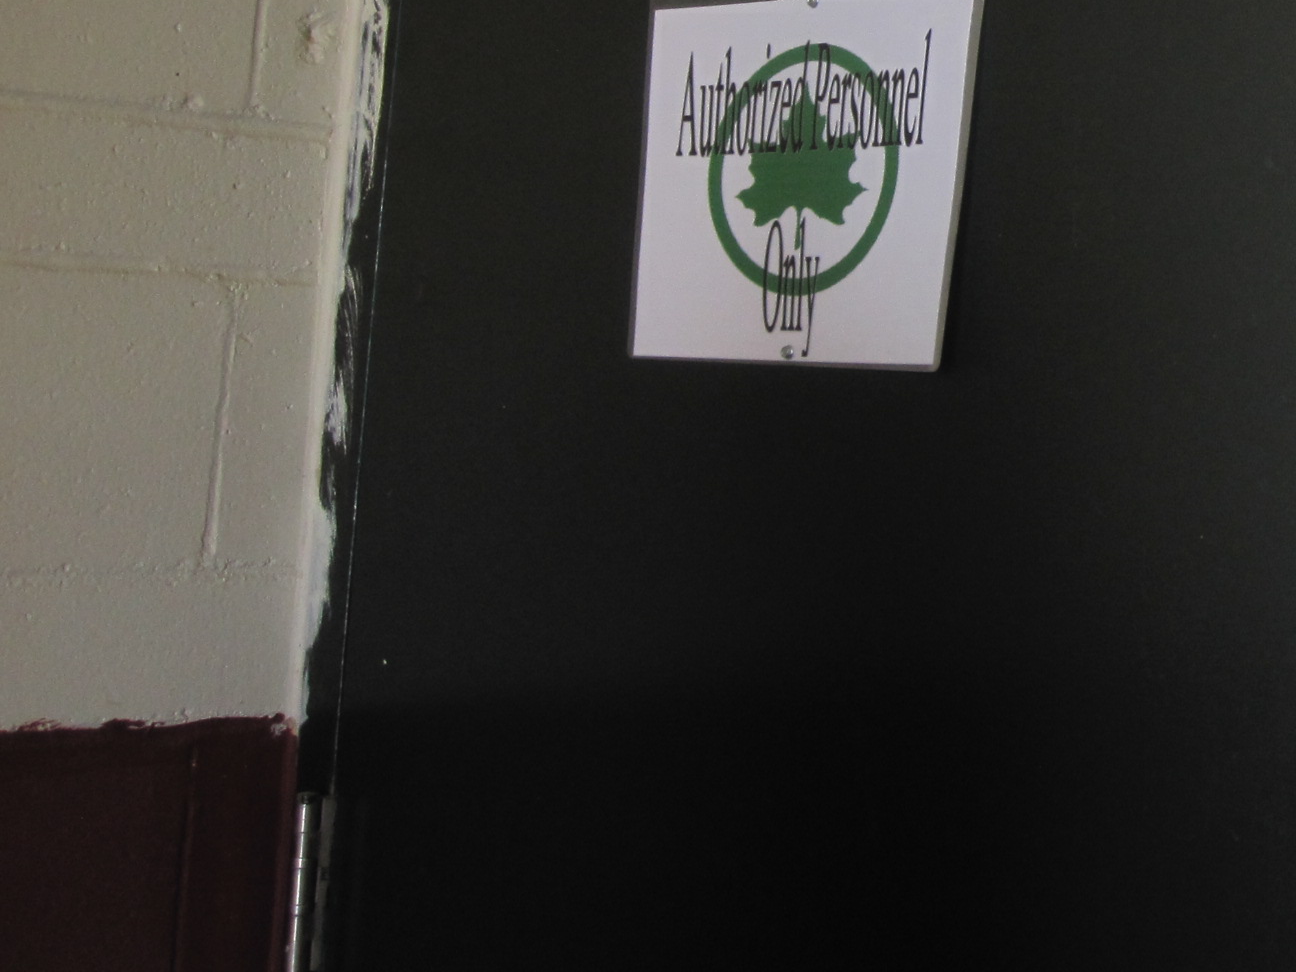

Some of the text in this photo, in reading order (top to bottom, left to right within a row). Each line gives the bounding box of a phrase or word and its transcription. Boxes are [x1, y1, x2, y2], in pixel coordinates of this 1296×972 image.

[675, 28, 932, 158] Authorized Personnel
[762, 218, 820, 357] Only
